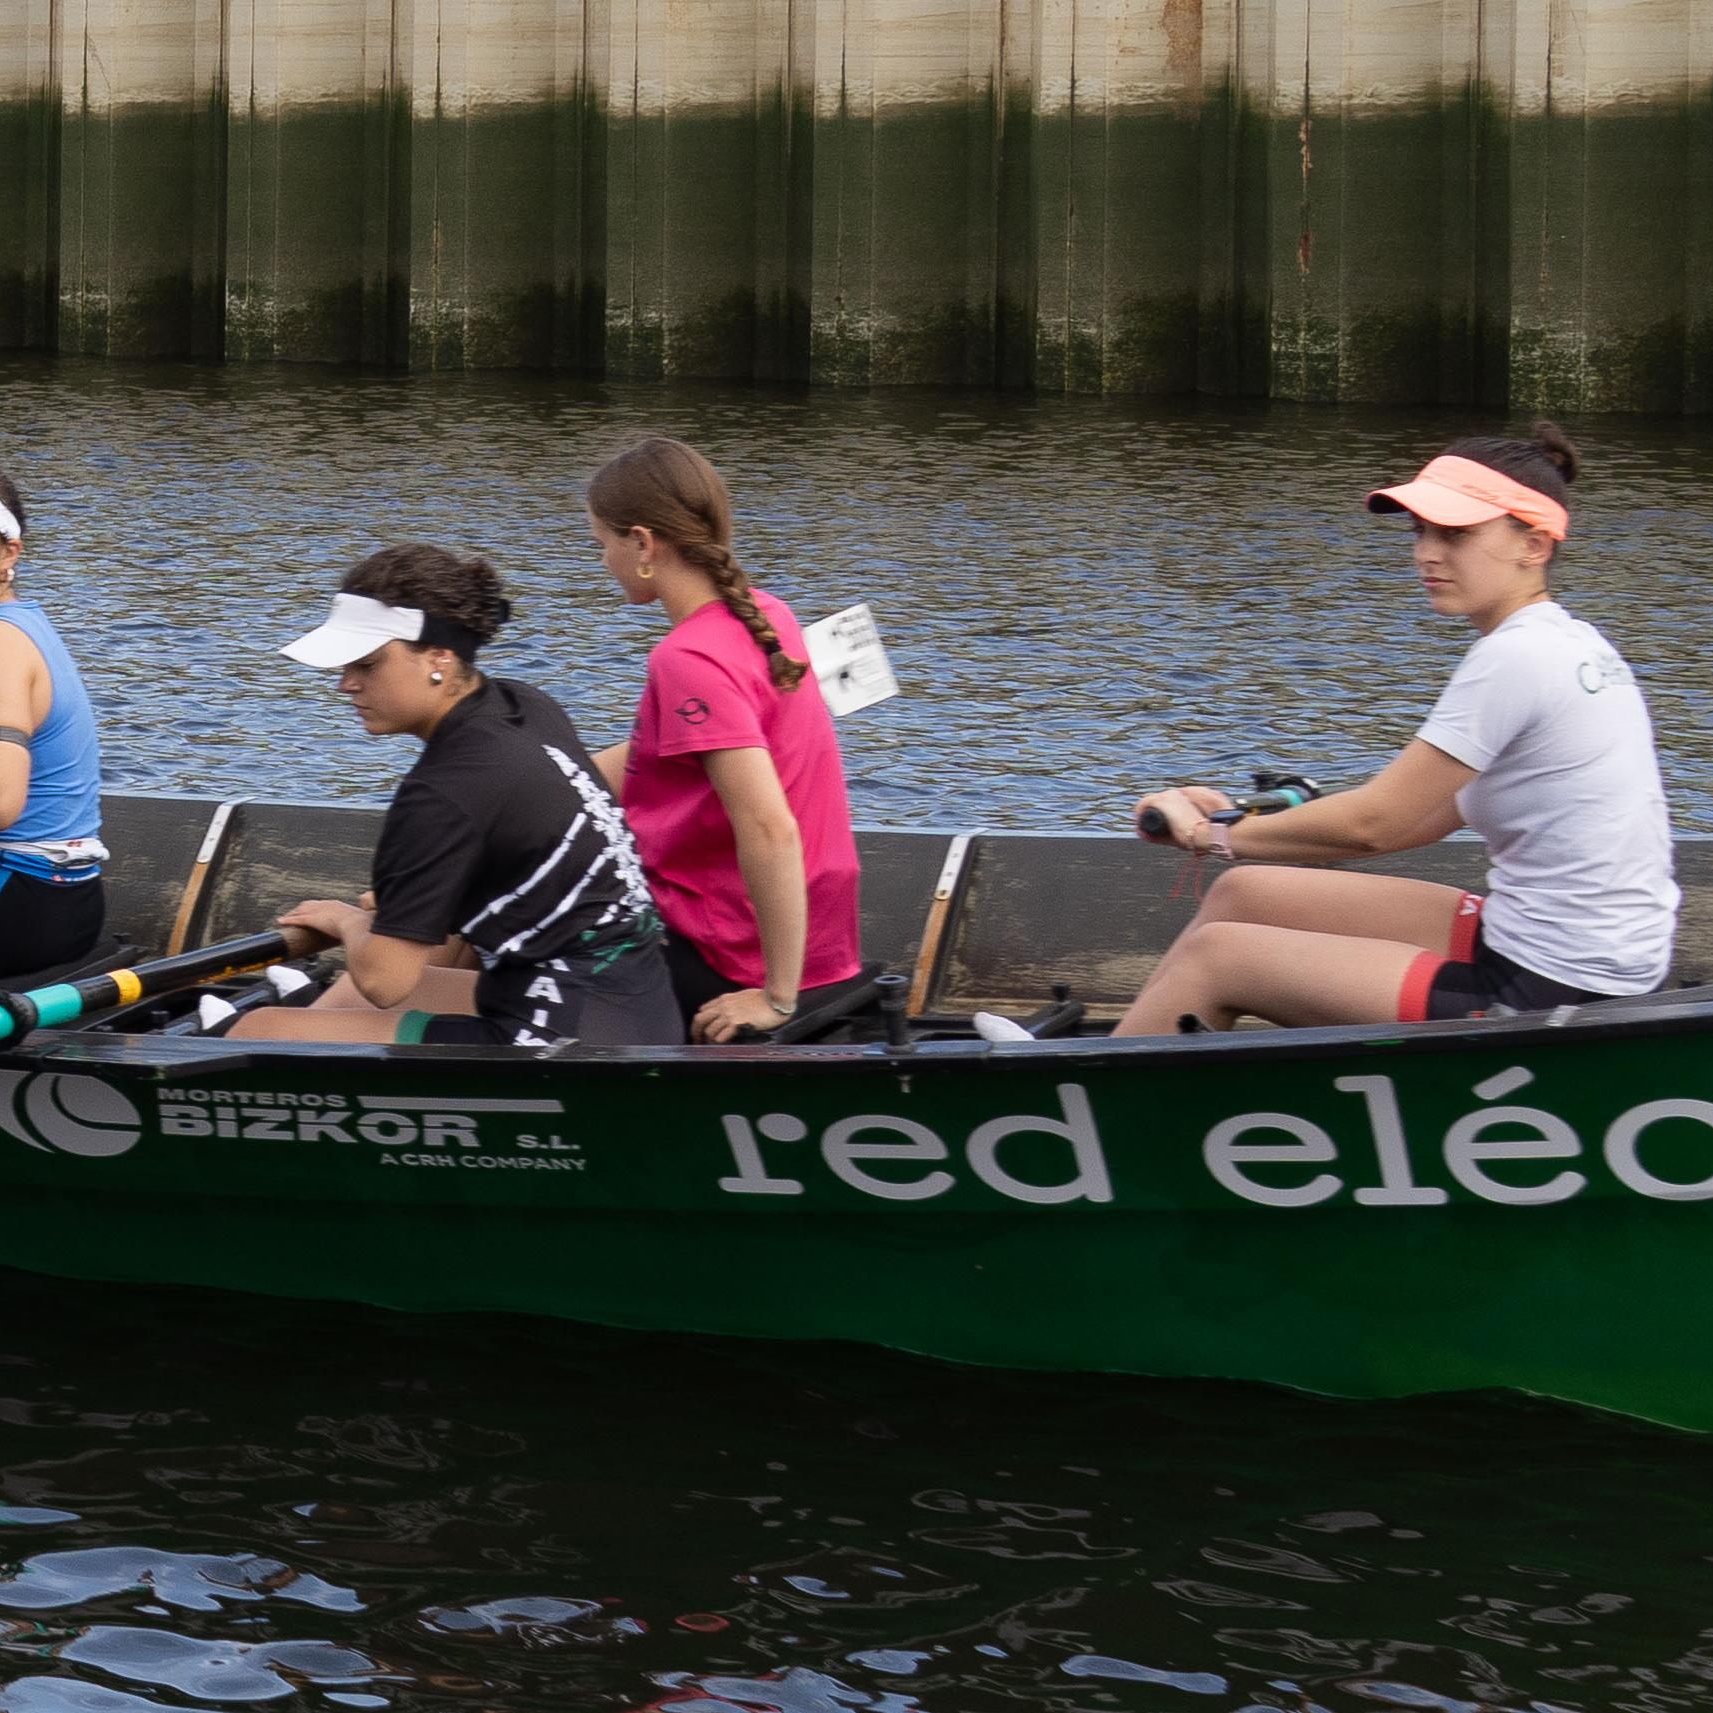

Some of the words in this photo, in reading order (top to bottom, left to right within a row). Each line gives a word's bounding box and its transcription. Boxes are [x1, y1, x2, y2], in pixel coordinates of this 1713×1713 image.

[157, 1087, 347, 1108] MORTEROS
[159, 1104, 482, 1148] BIZKOR
[516, 1134, 582, 1151] S.L.
[719, 1083, 1113, 1204] red
[380, 1154, 398, 1166] A
[401, 1154, 456, 1168] CRH
[461, 1156, 586, 1171] COMPANY
